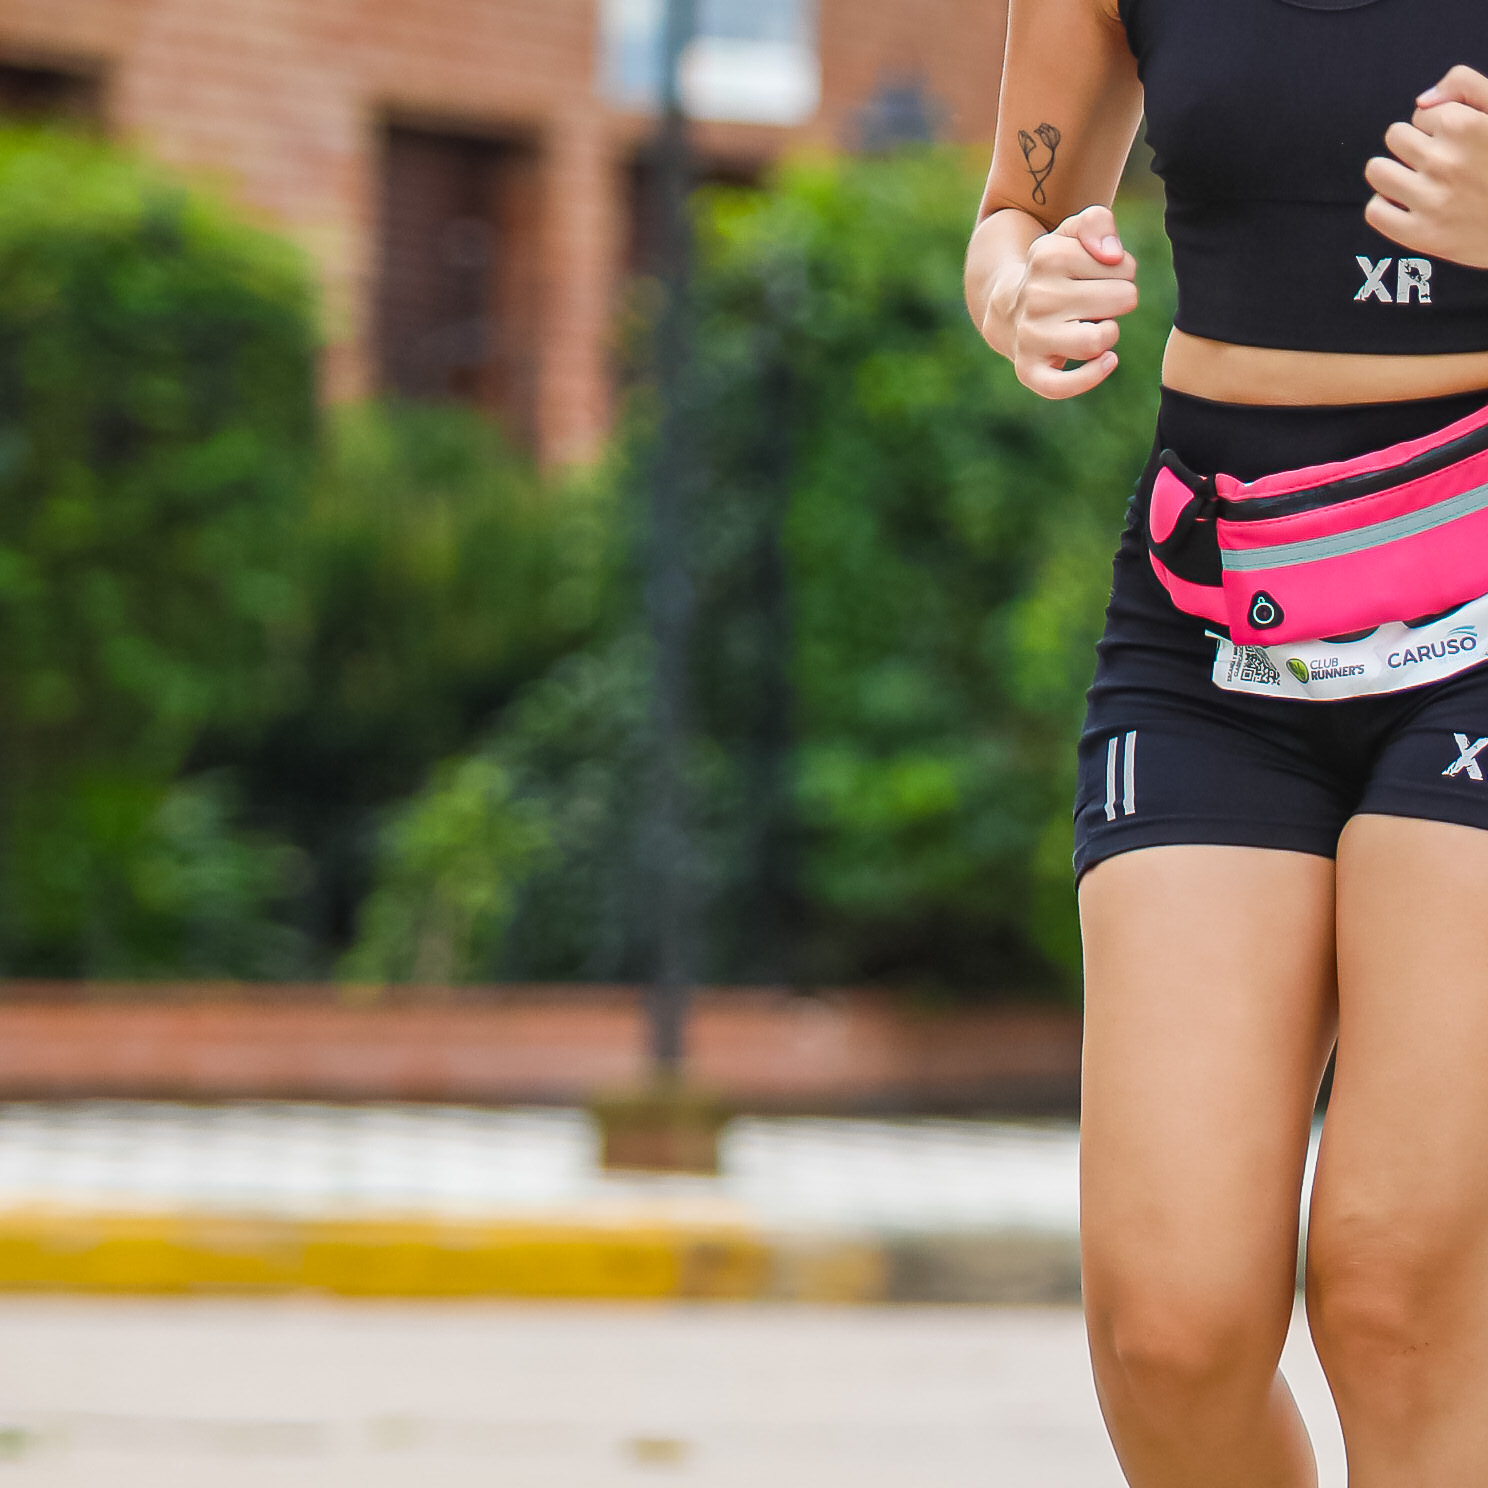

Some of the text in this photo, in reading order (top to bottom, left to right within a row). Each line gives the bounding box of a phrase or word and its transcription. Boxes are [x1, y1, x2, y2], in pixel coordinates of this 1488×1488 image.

[1353, 255, 1432, 304] XR
[1309, 657, 1339, 670] CLUB
[1387, 635, 1477, 669] CARUSO
[1310, 664, 1365, 681] RUNNER'S
